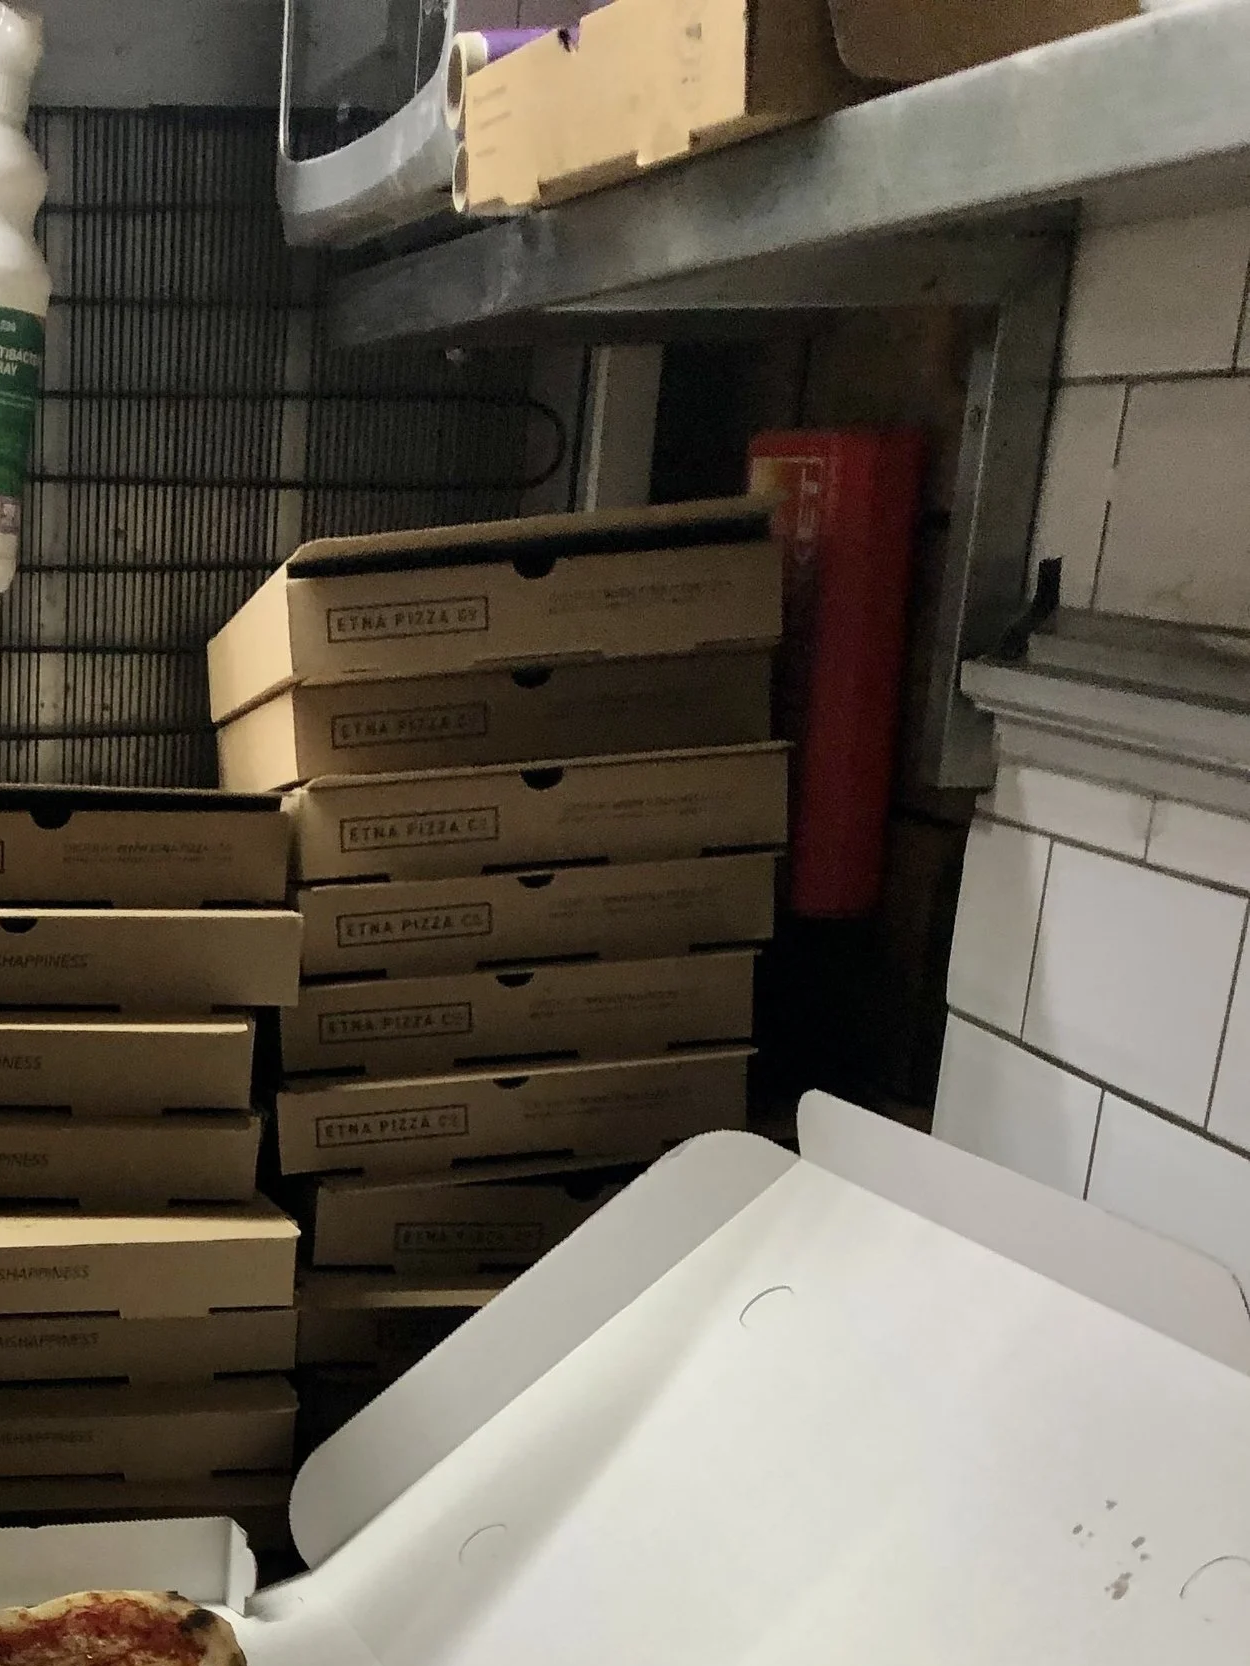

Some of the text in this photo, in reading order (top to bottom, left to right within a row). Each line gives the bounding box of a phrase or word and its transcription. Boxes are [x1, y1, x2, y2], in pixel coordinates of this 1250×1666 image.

[336, 615, 386, 632] ETNA
[394, 610, 449, 627] PIZZA
[349, 824, 400, 843] ETNA
[406, 818, 459, 837] PIZZA
[345, 919, 394, 938] ETNA
[401, 914, 454, 931] PIZZA
[326, 1019, 374, 1036] ETNA
[378, 1014, 434, 1031] PIZZA
[323, 1122, 372, 1139] ETNA
[379, 1115, 430, 1133] PIZZA
